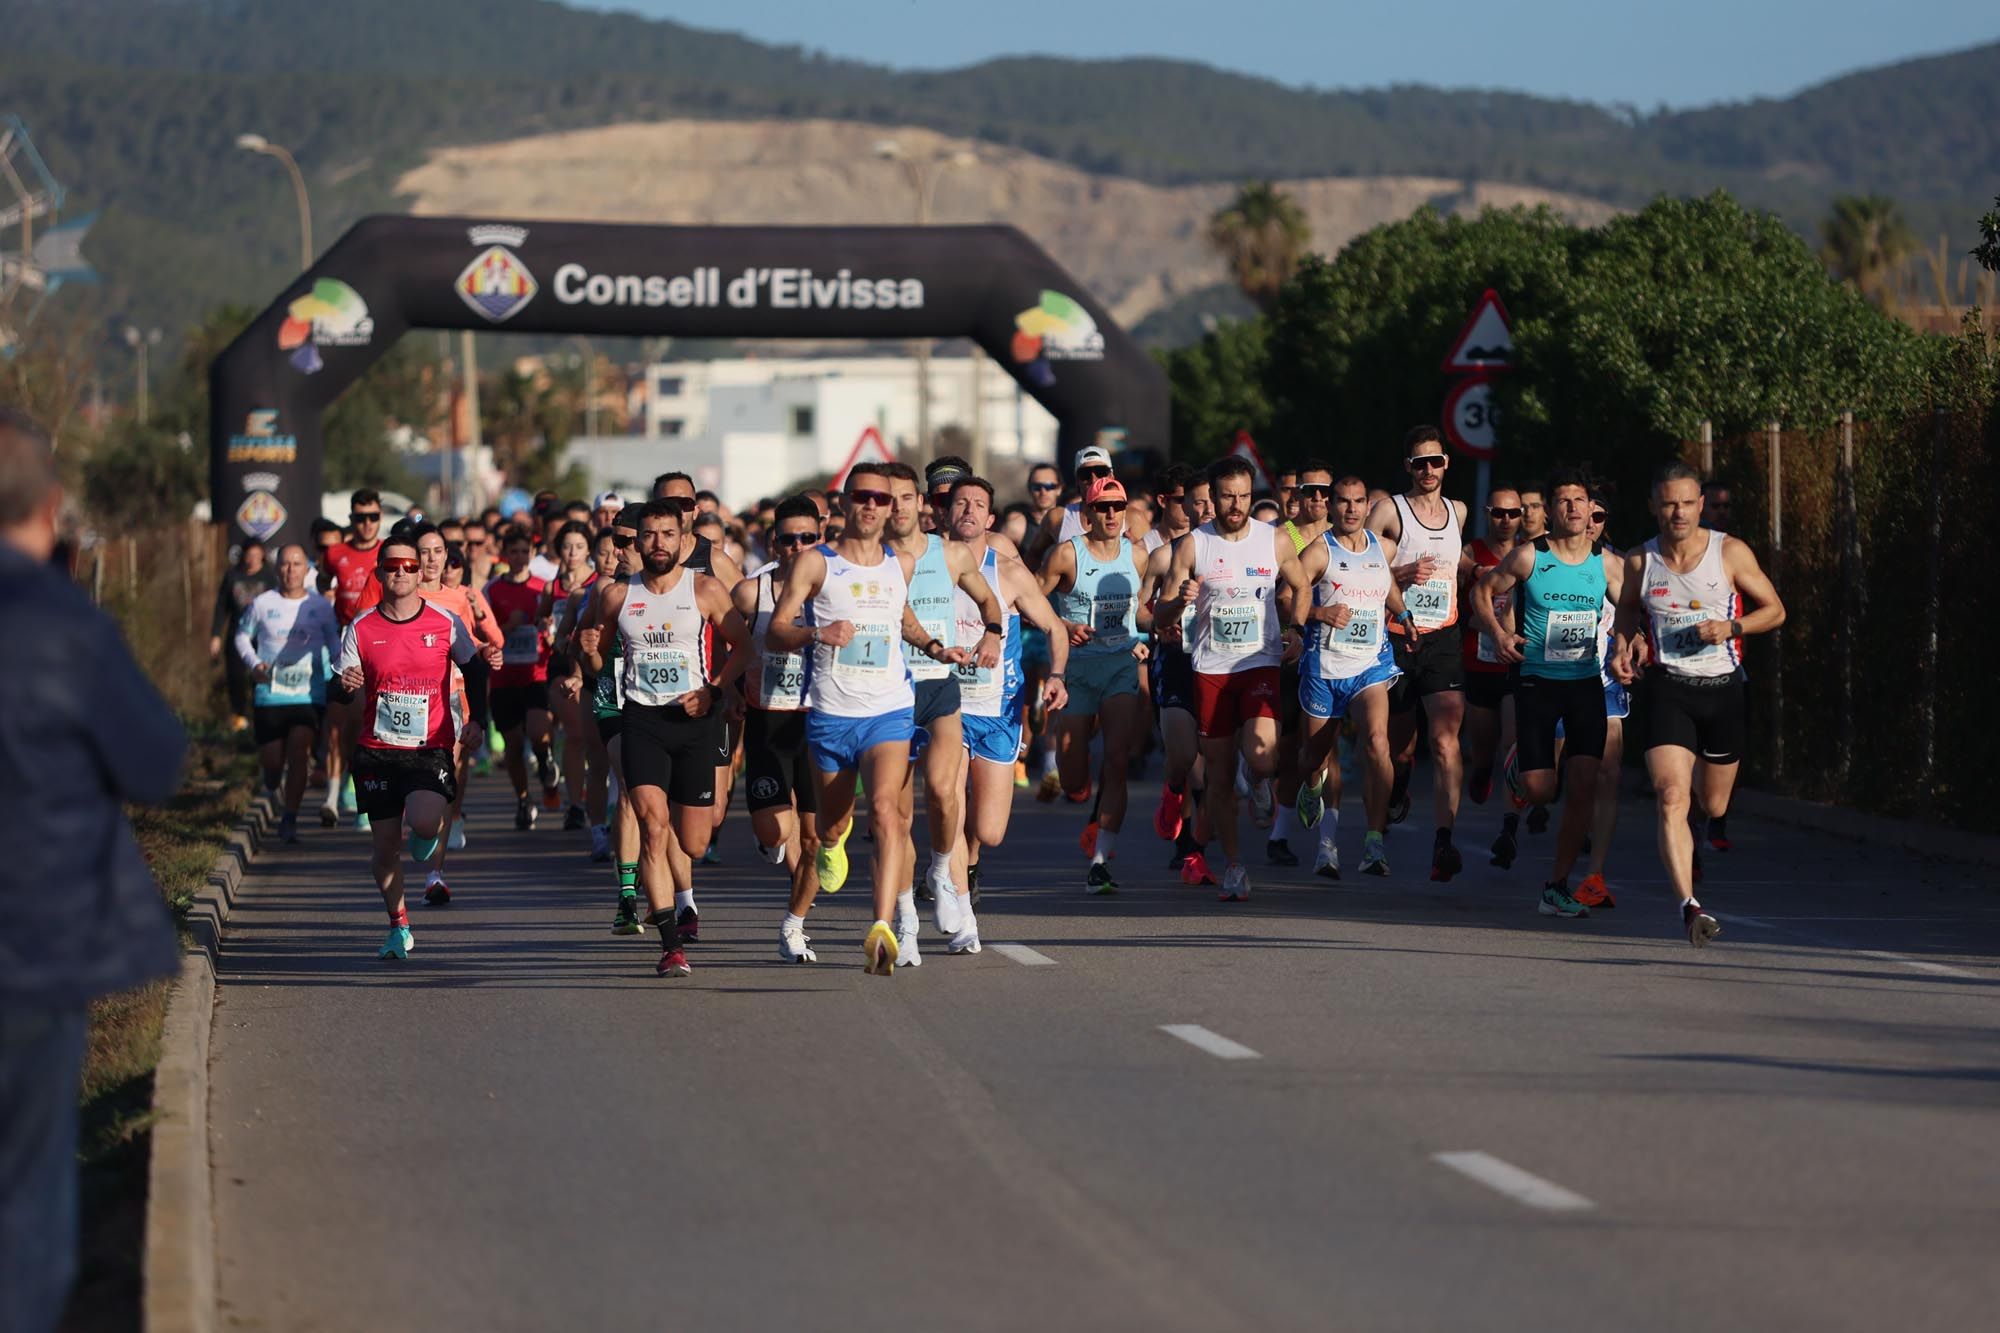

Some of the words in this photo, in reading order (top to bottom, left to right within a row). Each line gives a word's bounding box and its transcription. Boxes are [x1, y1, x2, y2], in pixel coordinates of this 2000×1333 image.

[553, 264, 720, 307] Consell
[727, 267, 924, 309] d’Eivissa
[1246, 567, 1271, 577] BigMat
[912, 597, 932, 606] EYES
[1415, 594, 1440, 609] 234
[1543, 592, 1595, 605] cecome
[1222, 606, 1256, 615] 5KIBIZA
[1562, 612, 1593, 621] 5KIBIZA
[1670, 612, 1708, 625] 5KIBIZA
[1224, 621, 1250, 635] 277
[1350, 623, 1368, 638] 38
[1560, 627, 1586, 643] 253
[642, 631, 675, 649] space
[646, 651, 685, 661] 5KIBIZA
[864, 641, 871, 658] 1
[775, 656, 802, 665] 5KIBI
[649, 667, 679, 684] 293
[958, 662, 977, 676] 65
[1700, 675, 1730, 687] PRO
[392, 710, 411, 727] 58
